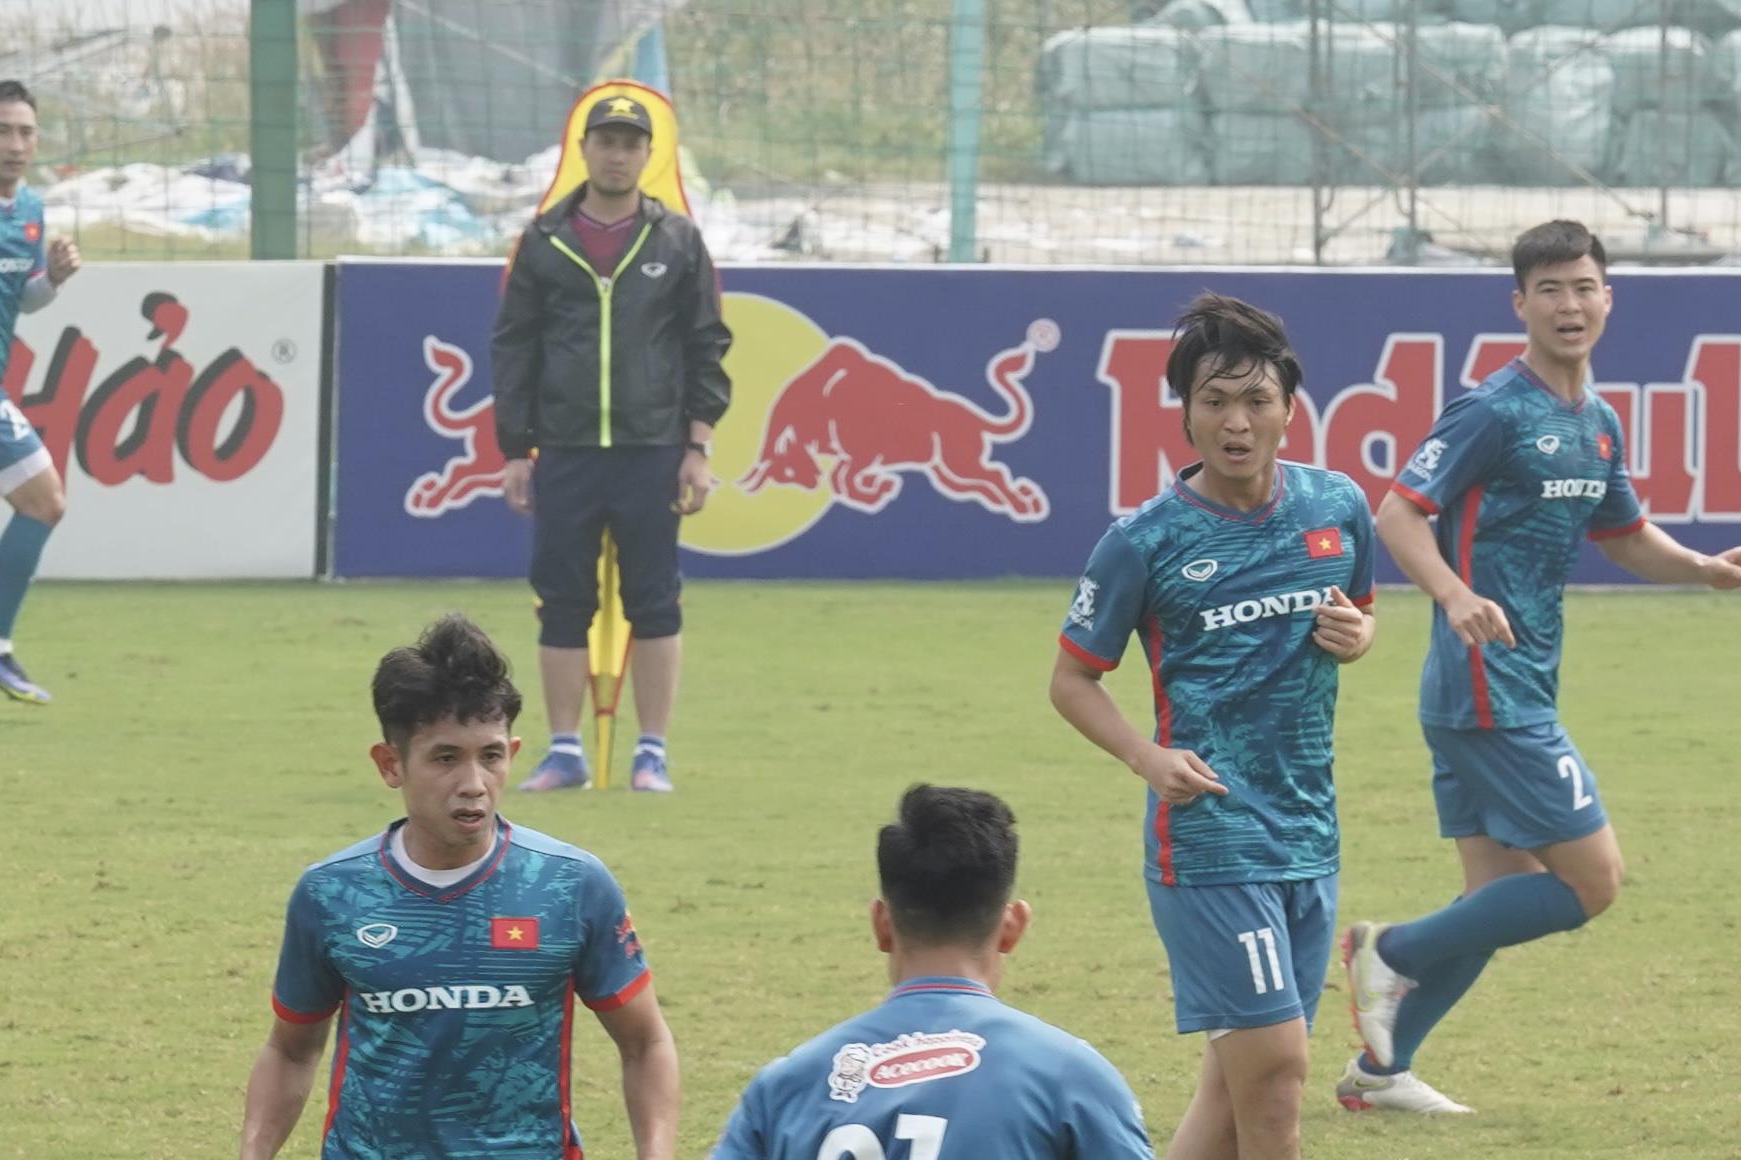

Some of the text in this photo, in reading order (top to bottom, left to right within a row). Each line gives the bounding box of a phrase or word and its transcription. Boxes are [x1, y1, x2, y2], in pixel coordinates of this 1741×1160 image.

[1096, 329, 1444, 522] Rd
[1557, 755, 1594, 811] 2
[1237, 927, 1285, 995] 11
[359, 984, 536, 1014] HONDA
